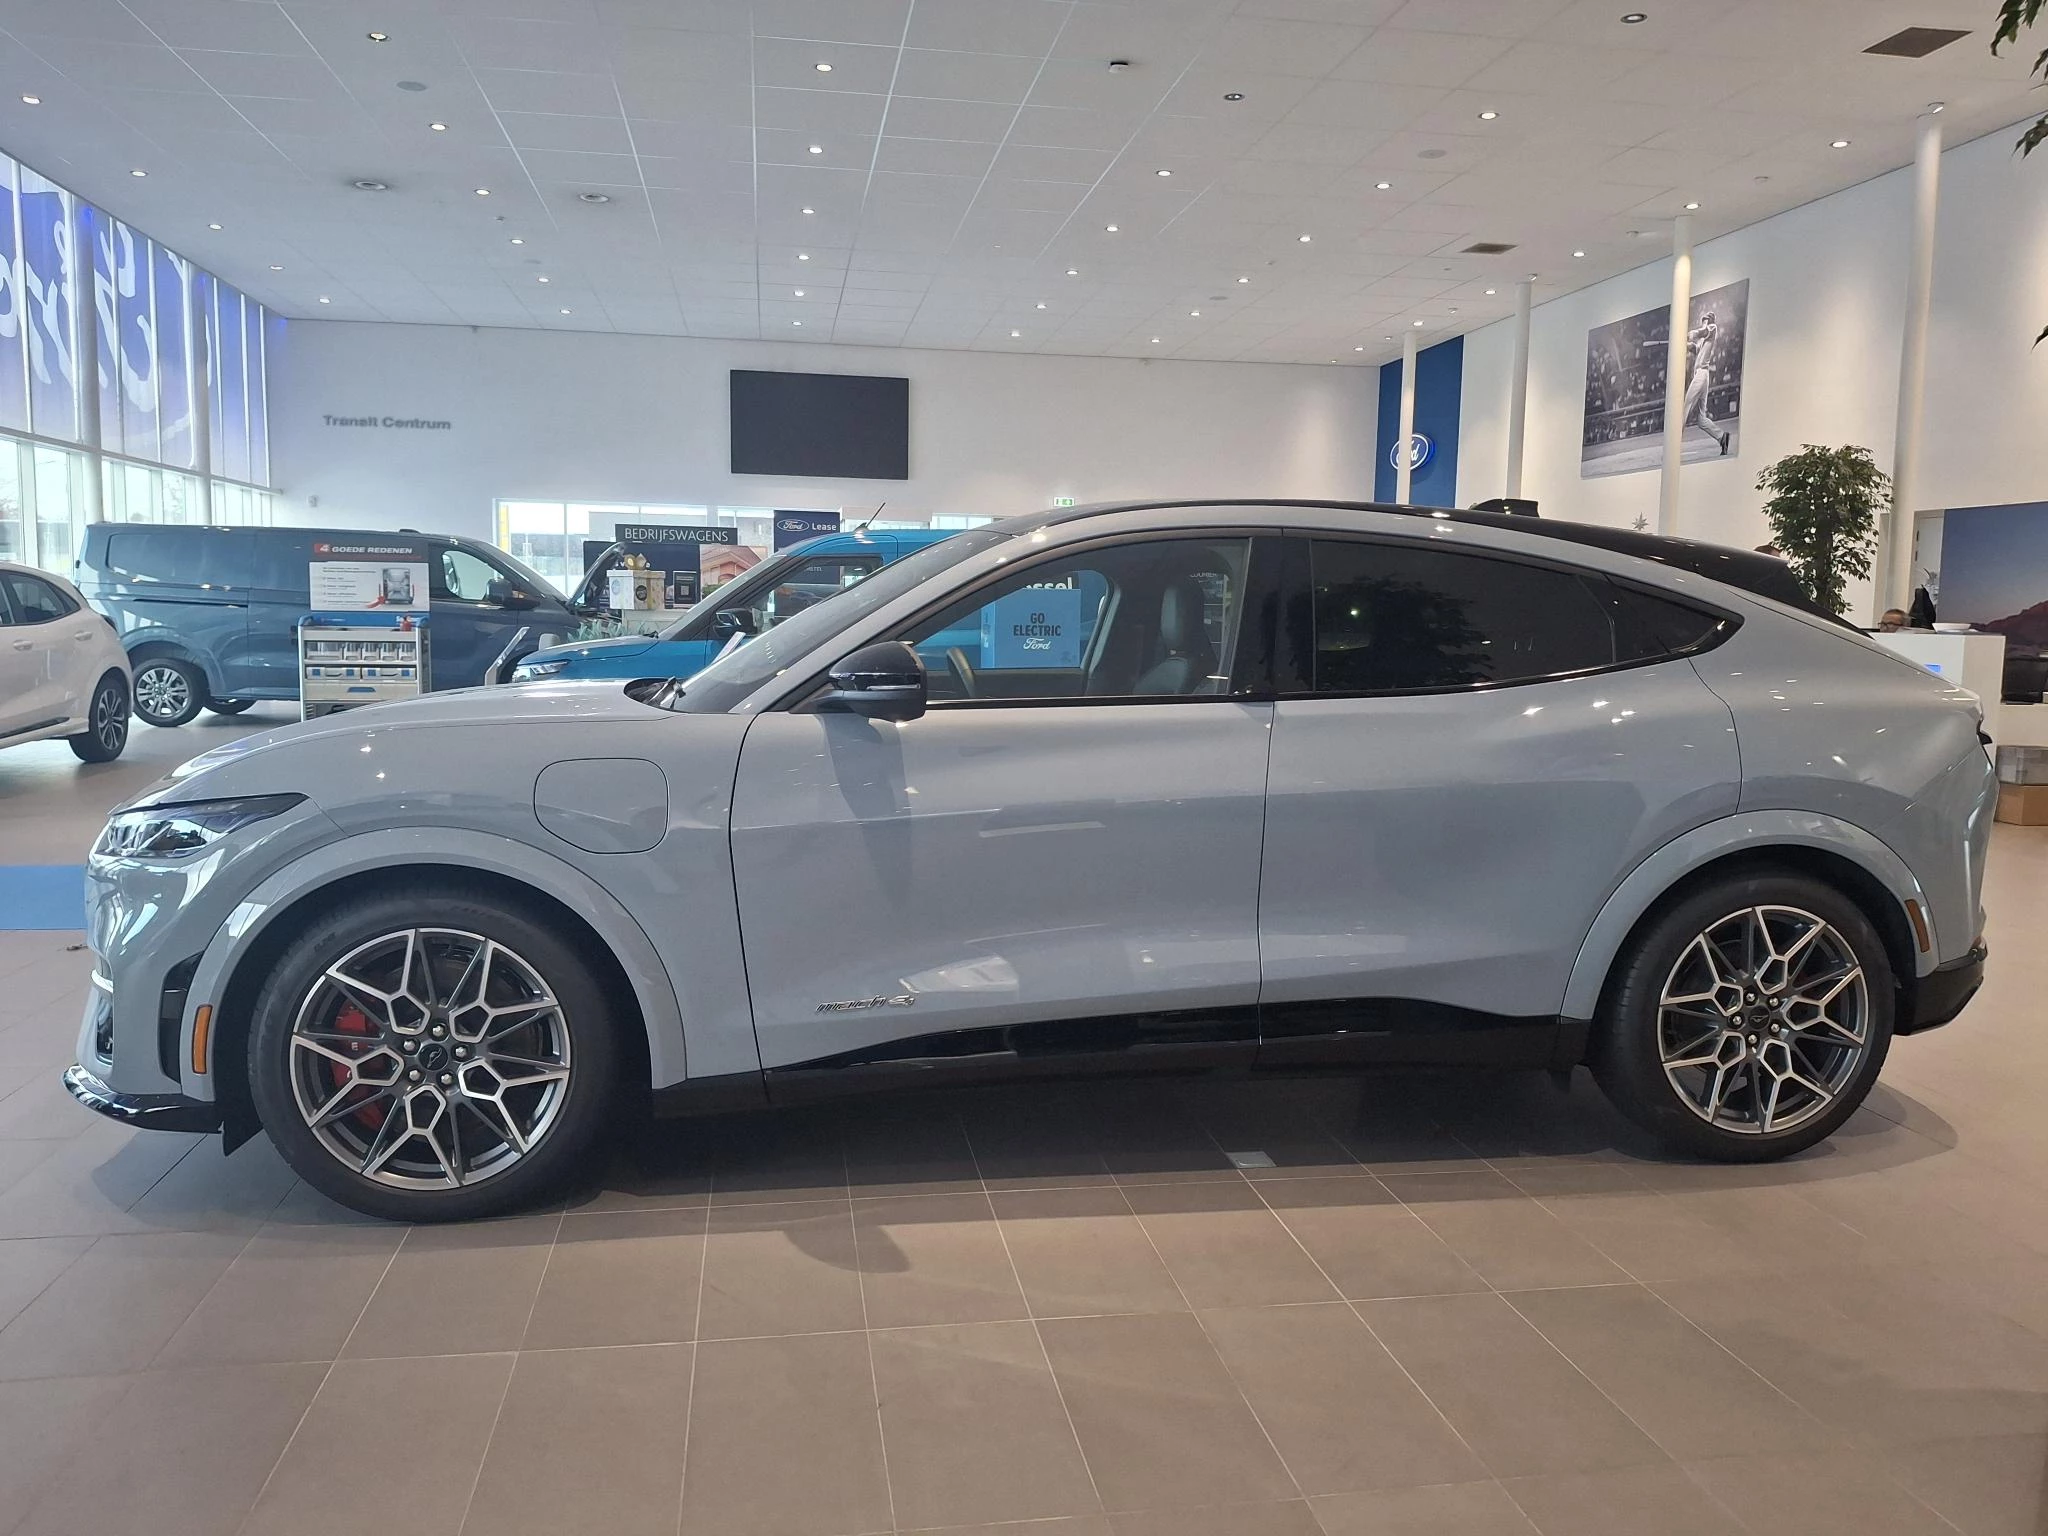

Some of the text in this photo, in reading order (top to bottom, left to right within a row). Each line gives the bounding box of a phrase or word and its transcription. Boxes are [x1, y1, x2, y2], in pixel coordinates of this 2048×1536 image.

[323, 415, 452, 430] Transit Centrum
[812, 522, 837, 531] Lease
[624, 527, 729, 543] BEDRIJFSWAGENS
[332, 546, 366, 554] GOEDE
[367, 546, 413, 555] REDENEN
[1030, 612, 1045, 624] GO
[1013, 624, 1062, 637] ELECTRIC
[1023, 637, 1052, 650] Ford
